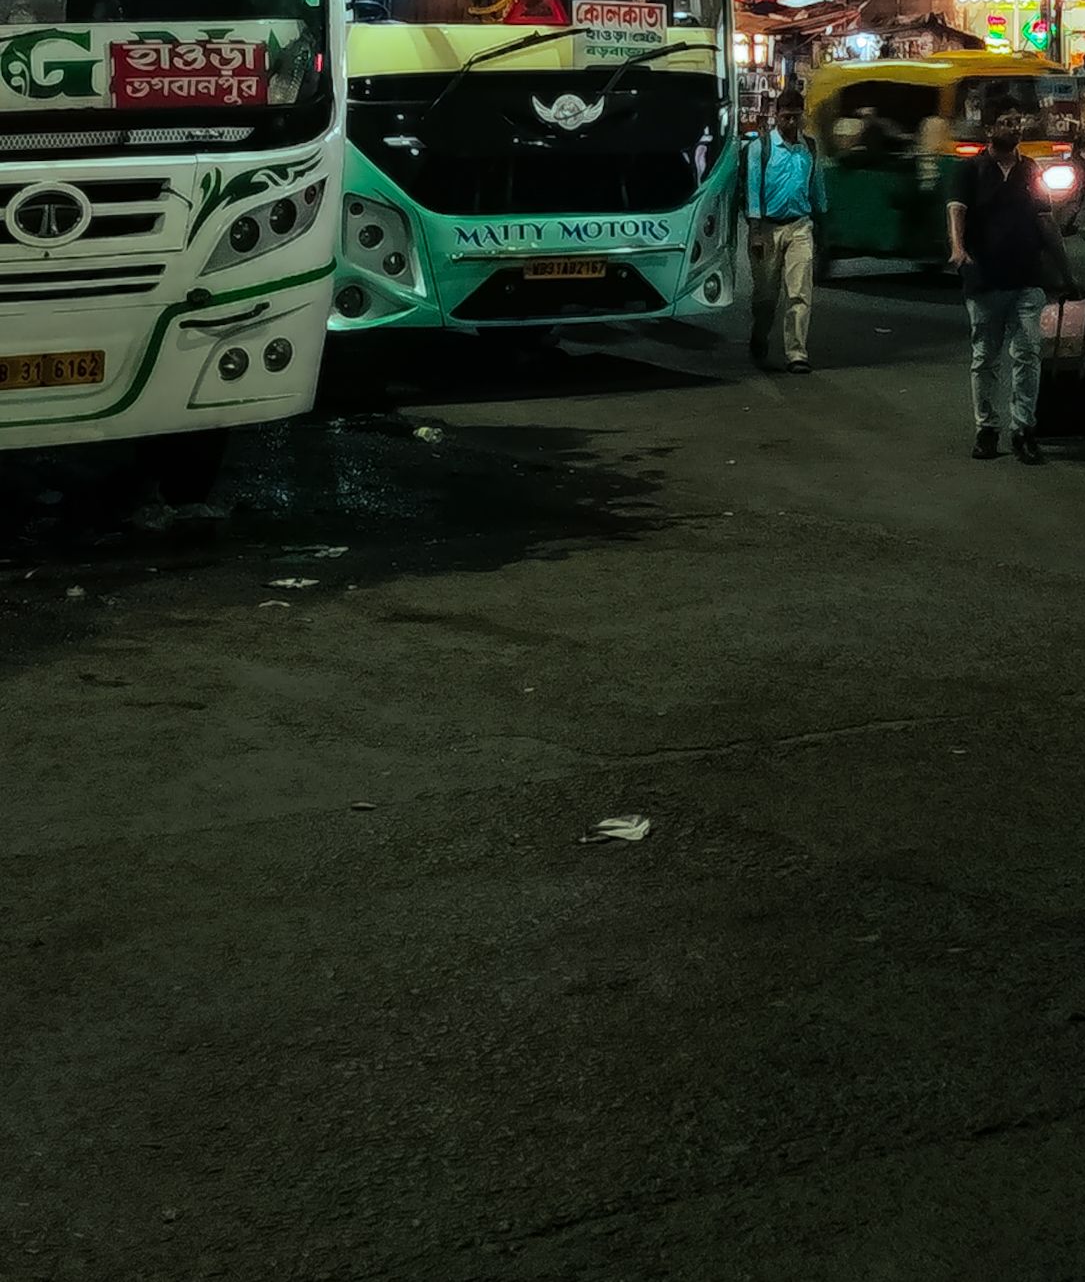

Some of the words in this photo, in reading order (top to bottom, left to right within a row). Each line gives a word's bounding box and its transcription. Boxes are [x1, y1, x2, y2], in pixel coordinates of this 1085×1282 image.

[575, 2, 665, 30] কোলকাতা
[124, 42, 258, 76] হাওড়া
[125, 75, 260, 105] ভগবানপুর
[454, 222, 549, 248] MAITY
[557, 219, 673, 243] MOTORS
[55, 358, 98, 379] 6162
